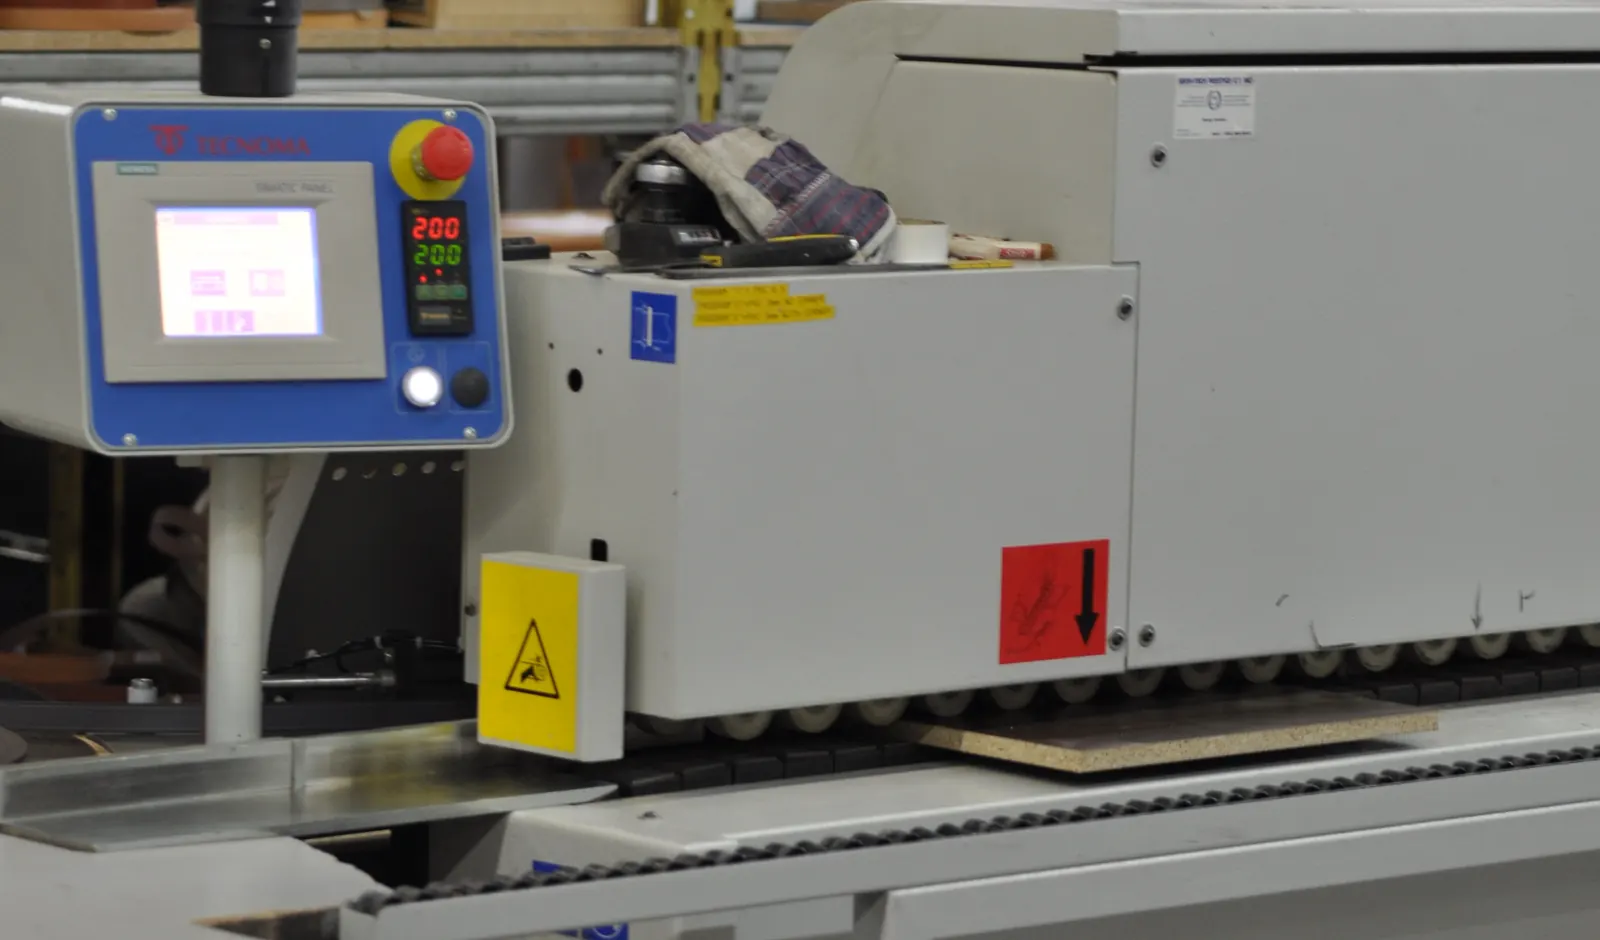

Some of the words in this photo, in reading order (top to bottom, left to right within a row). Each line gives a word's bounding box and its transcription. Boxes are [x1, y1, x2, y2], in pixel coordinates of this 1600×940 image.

[197, 136, 311, 155] TECNOMA
[411, 216, 461, 240] 200
[414, 243, 463, 266] 200
